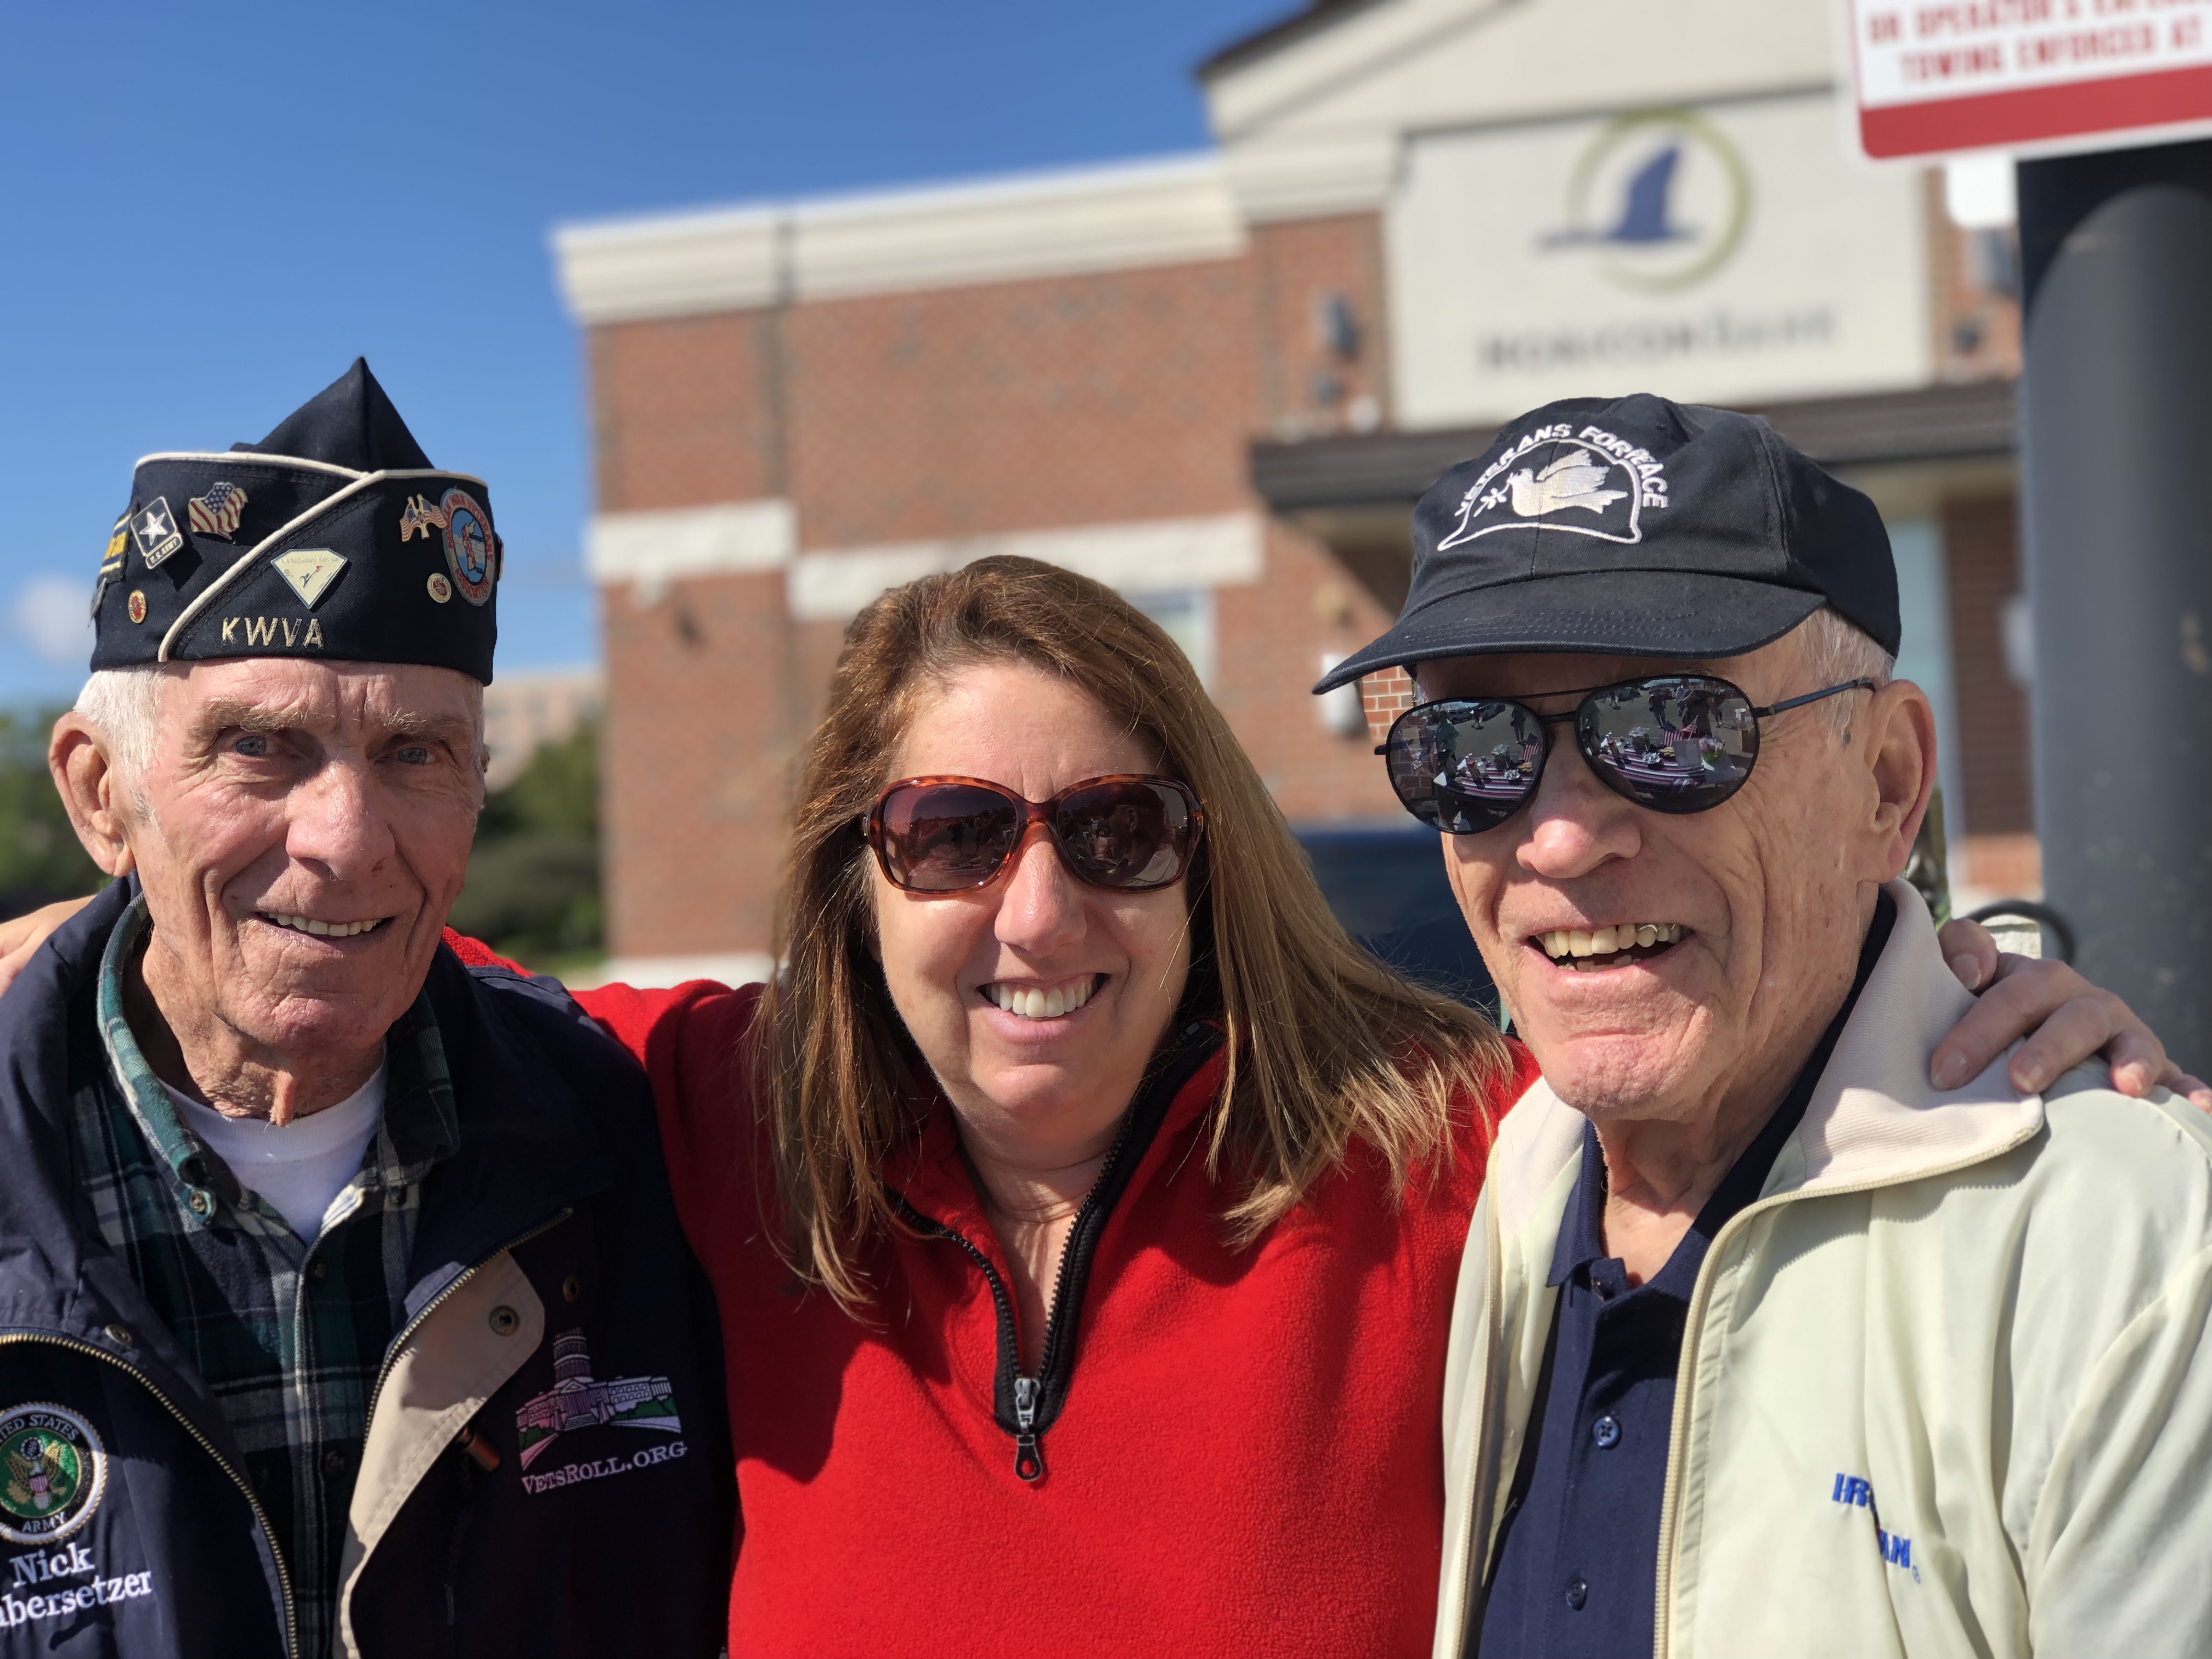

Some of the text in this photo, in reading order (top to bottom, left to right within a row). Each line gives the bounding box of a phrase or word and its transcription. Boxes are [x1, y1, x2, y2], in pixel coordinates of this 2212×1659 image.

[1900, 44, 2004, 82] TOWING
[2017, 21, 2155, 71] ENFORCED
[221, 616, 324, 650] KWVA
[29, 1414, 78, 1441] STATES
[22, 1511, 67, 1533] ARMY
[9, 1542, 95, 1589] Nick
